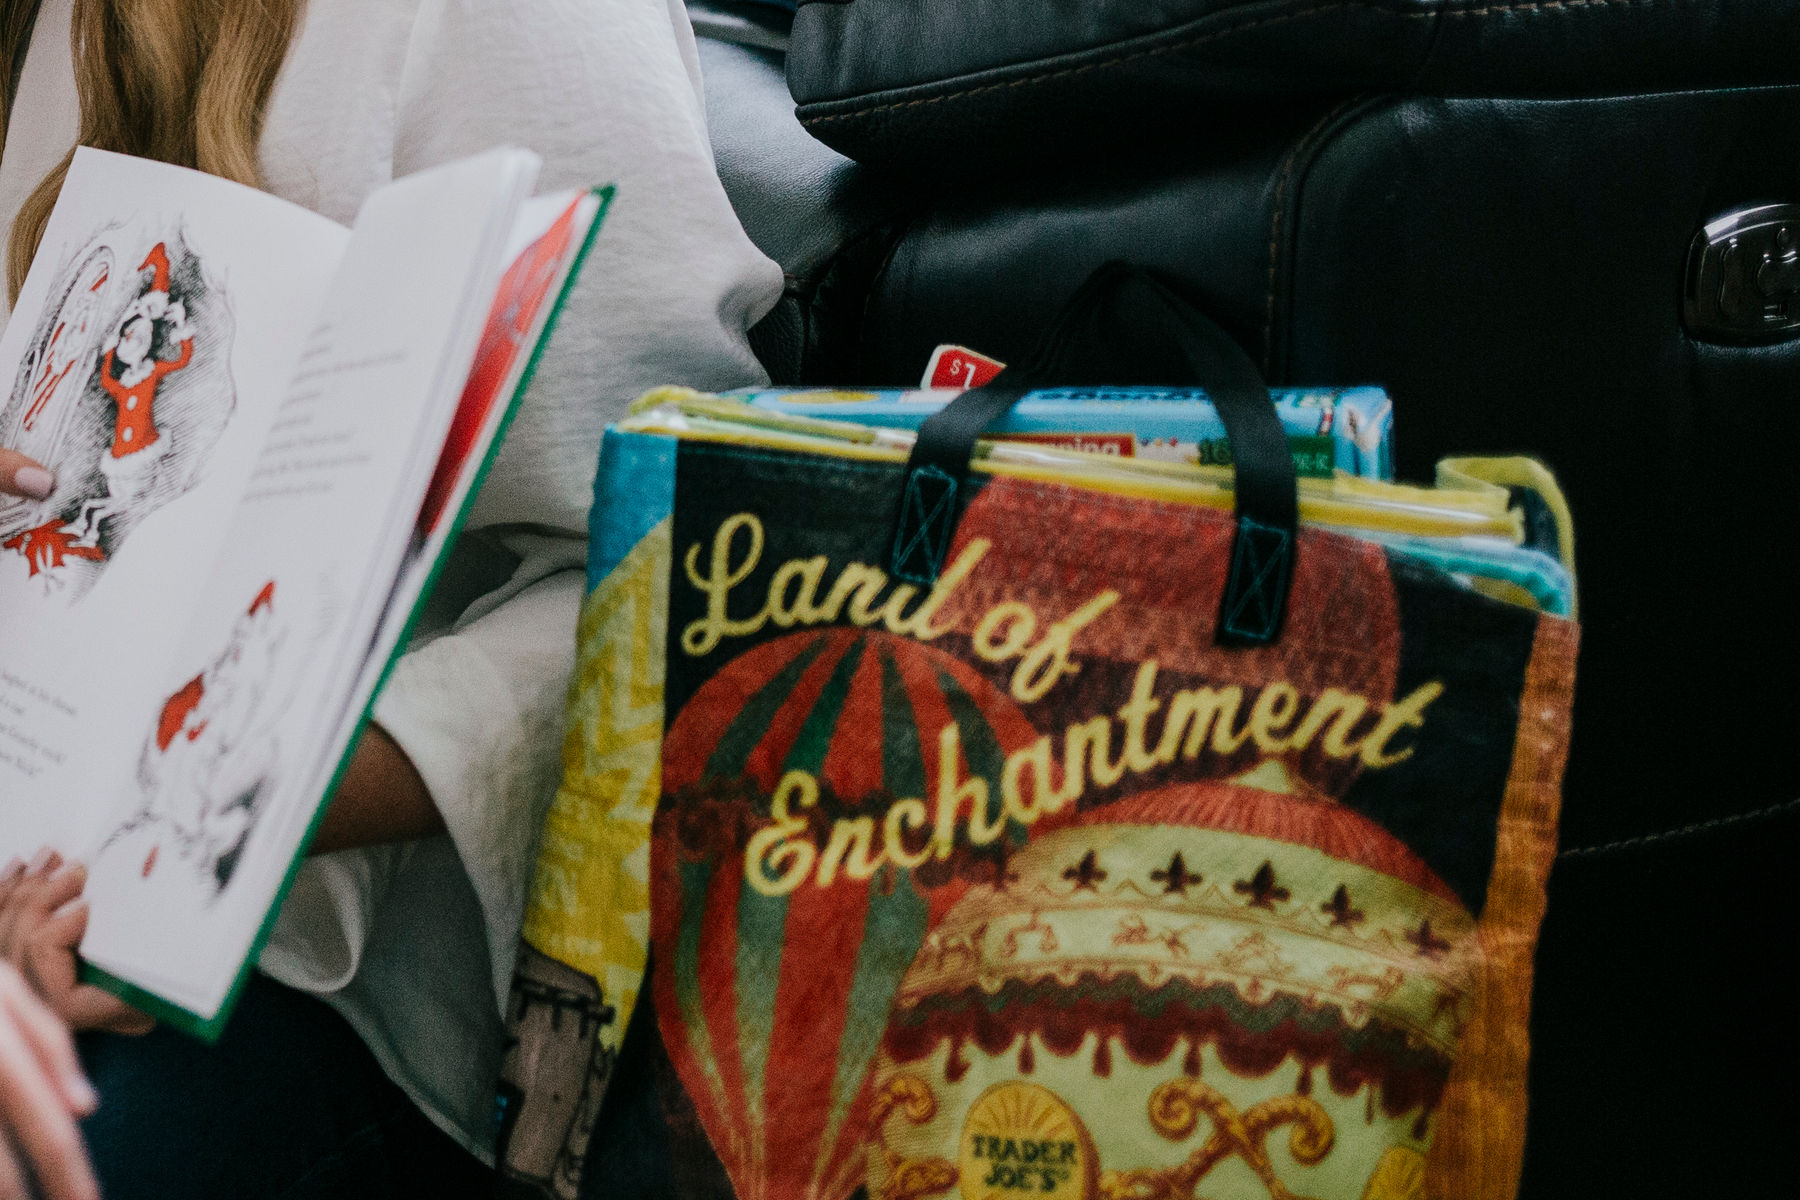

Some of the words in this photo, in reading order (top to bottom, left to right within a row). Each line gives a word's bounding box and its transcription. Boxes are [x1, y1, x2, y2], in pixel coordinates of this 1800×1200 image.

[681, 512, 993, 656] Land
[972, 590, 1121, 703] of
[745, 661, 1445, 897] Enchantment
[972, 1134, 1076, 1164] TRADER
